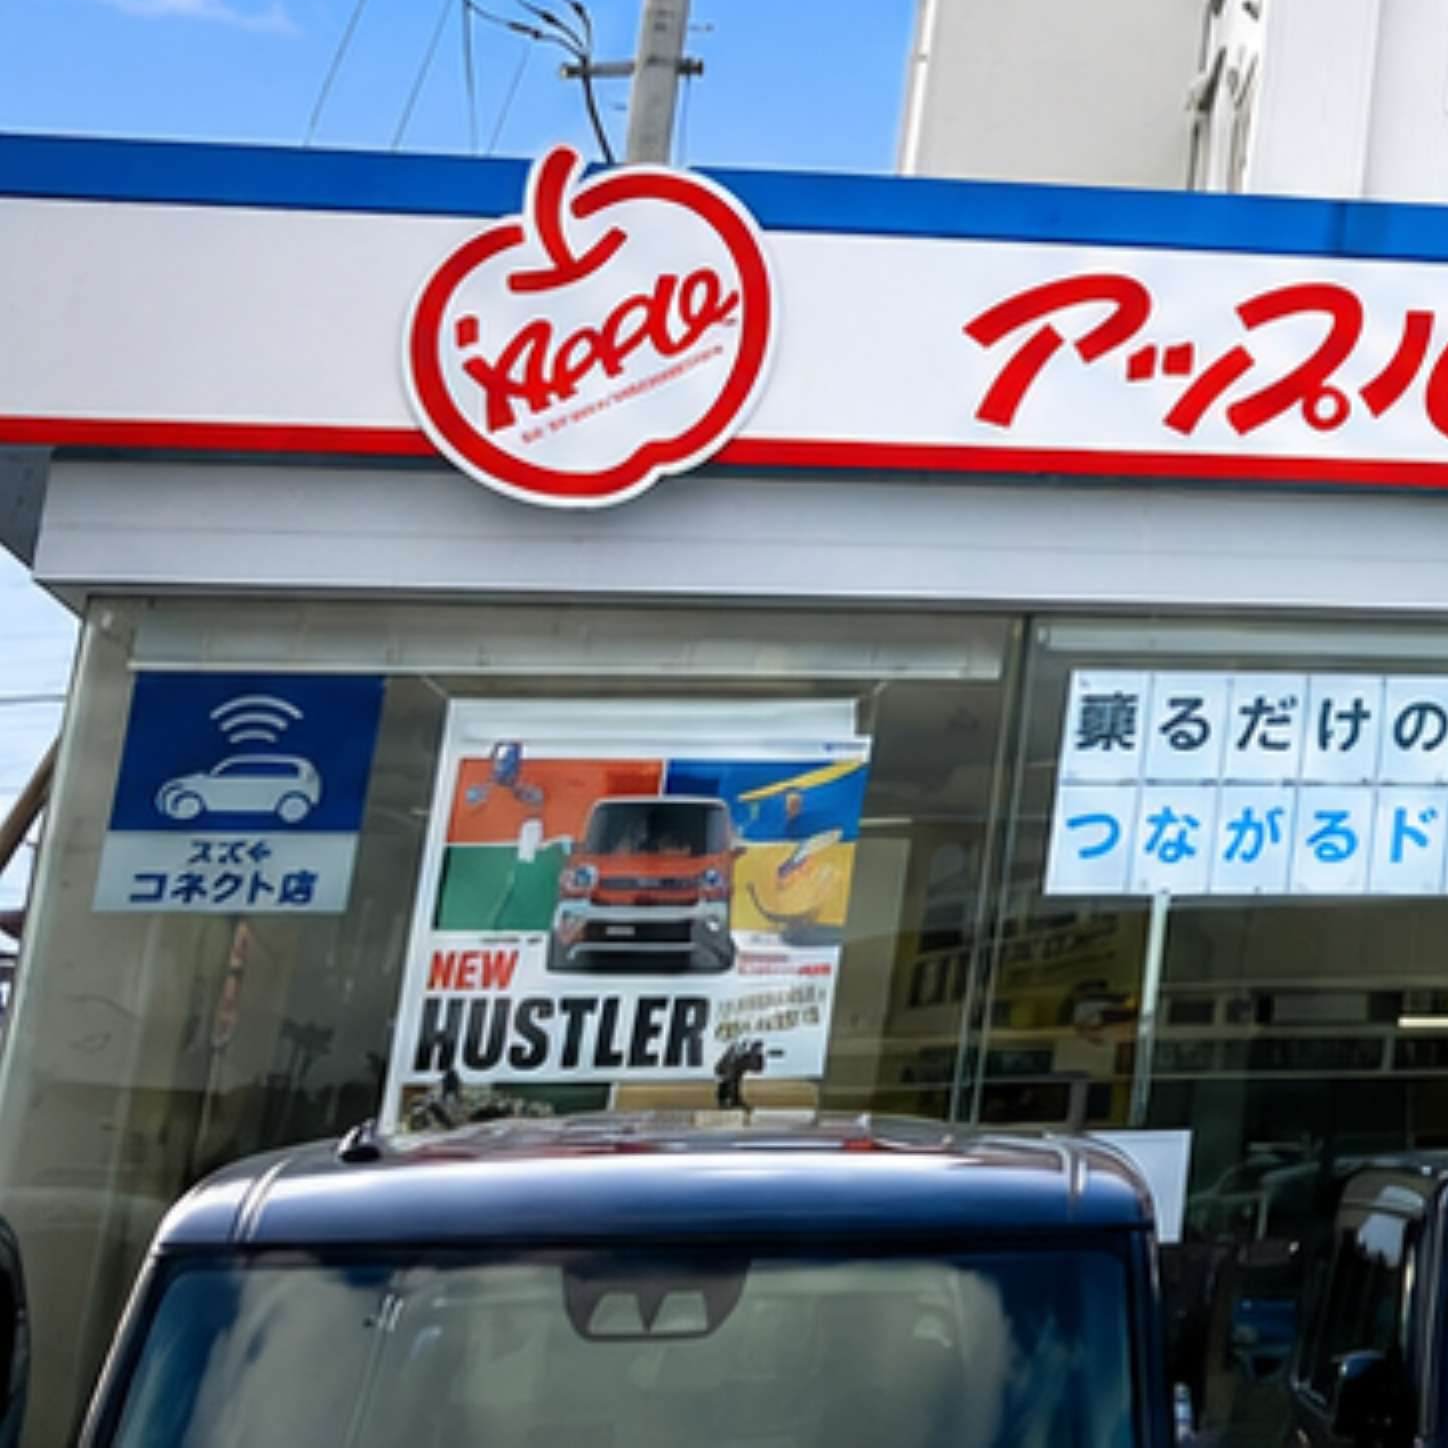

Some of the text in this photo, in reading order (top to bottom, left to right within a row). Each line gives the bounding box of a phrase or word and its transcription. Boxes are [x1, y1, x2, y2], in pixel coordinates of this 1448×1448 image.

[129, 869, 319, 906] コネクト店
[426, 949, 519, 991] NEW
[414, 995, 711, 1072] HUSTLER
